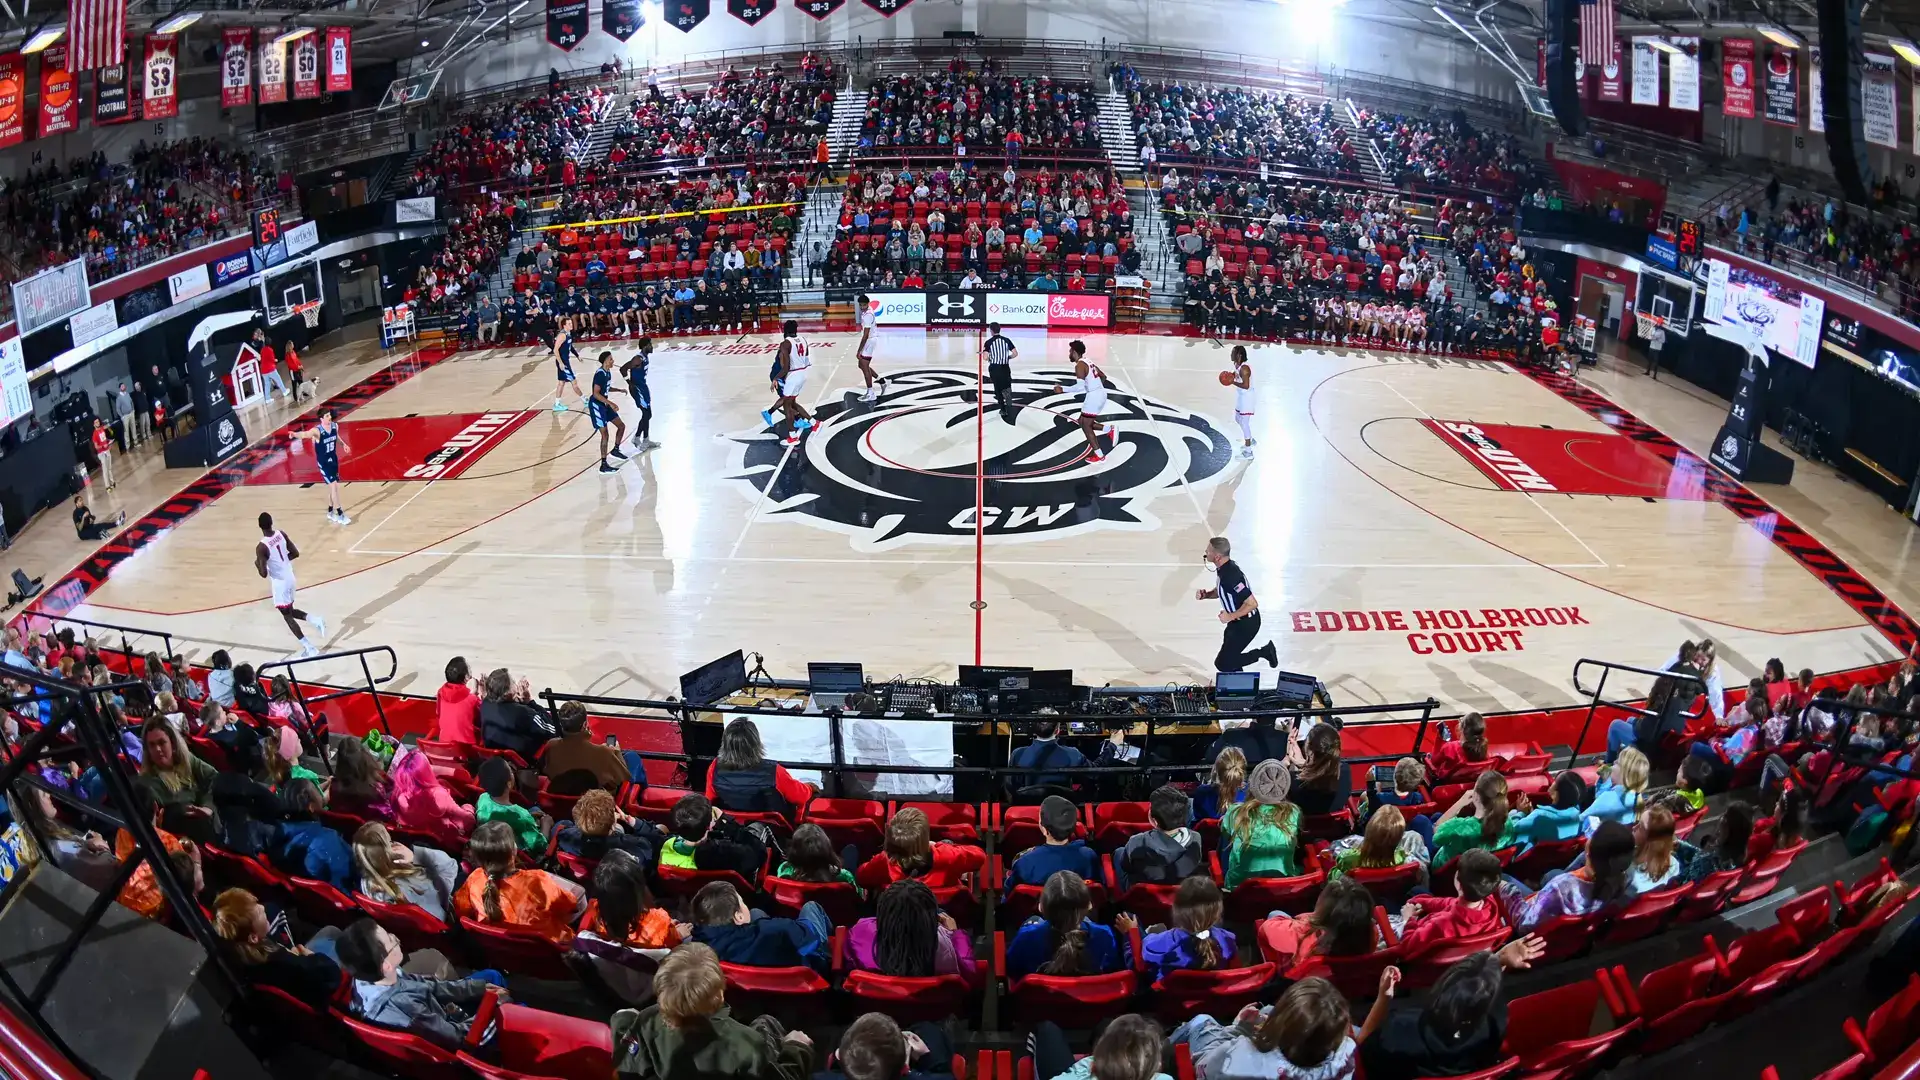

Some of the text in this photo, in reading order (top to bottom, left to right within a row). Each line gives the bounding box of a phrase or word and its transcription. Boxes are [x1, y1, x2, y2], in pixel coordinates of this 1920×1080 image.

[811, 2, 829, 11] 30-3
[879, 0, 896, 8] 31-5
[560, 34, 576, 44] 17-10
[335, 50, 343, 60] 21
[228, 60, 245, 77] 52
[265, 59, 280, 75] 22
[299, 56, 314, 72] 50
[151, 67, 170, 87] 53
[49, 82, 70, 93] 1991-92
[101, 88, 124, 98] CHAMPIONS
[44, 99, 73, 114] CHAMPIONS
[98, 100, 126, 114] FOOTBALL
[46, 121, 71, 132] BASKETBALL
[154, 123, 164, 137] 15
[1795, 135, 1804, 150] 18
[31, 150, 43, 165] 14
[262, 221, 278, 244] 29
[172, 276, 183, 297] P
[886, 302, 925, 317] pepsi
[1002, 304, 1046, 315] Bank OZK
[326, 441, 335, 453] 15
[947, 502, 1076, 529] GW
[276, 544, 286, 562] 1
[1288, 606, 1590, 633] EDDIE HOLBROOK
[1406, 630, 1524, 655] COURT
